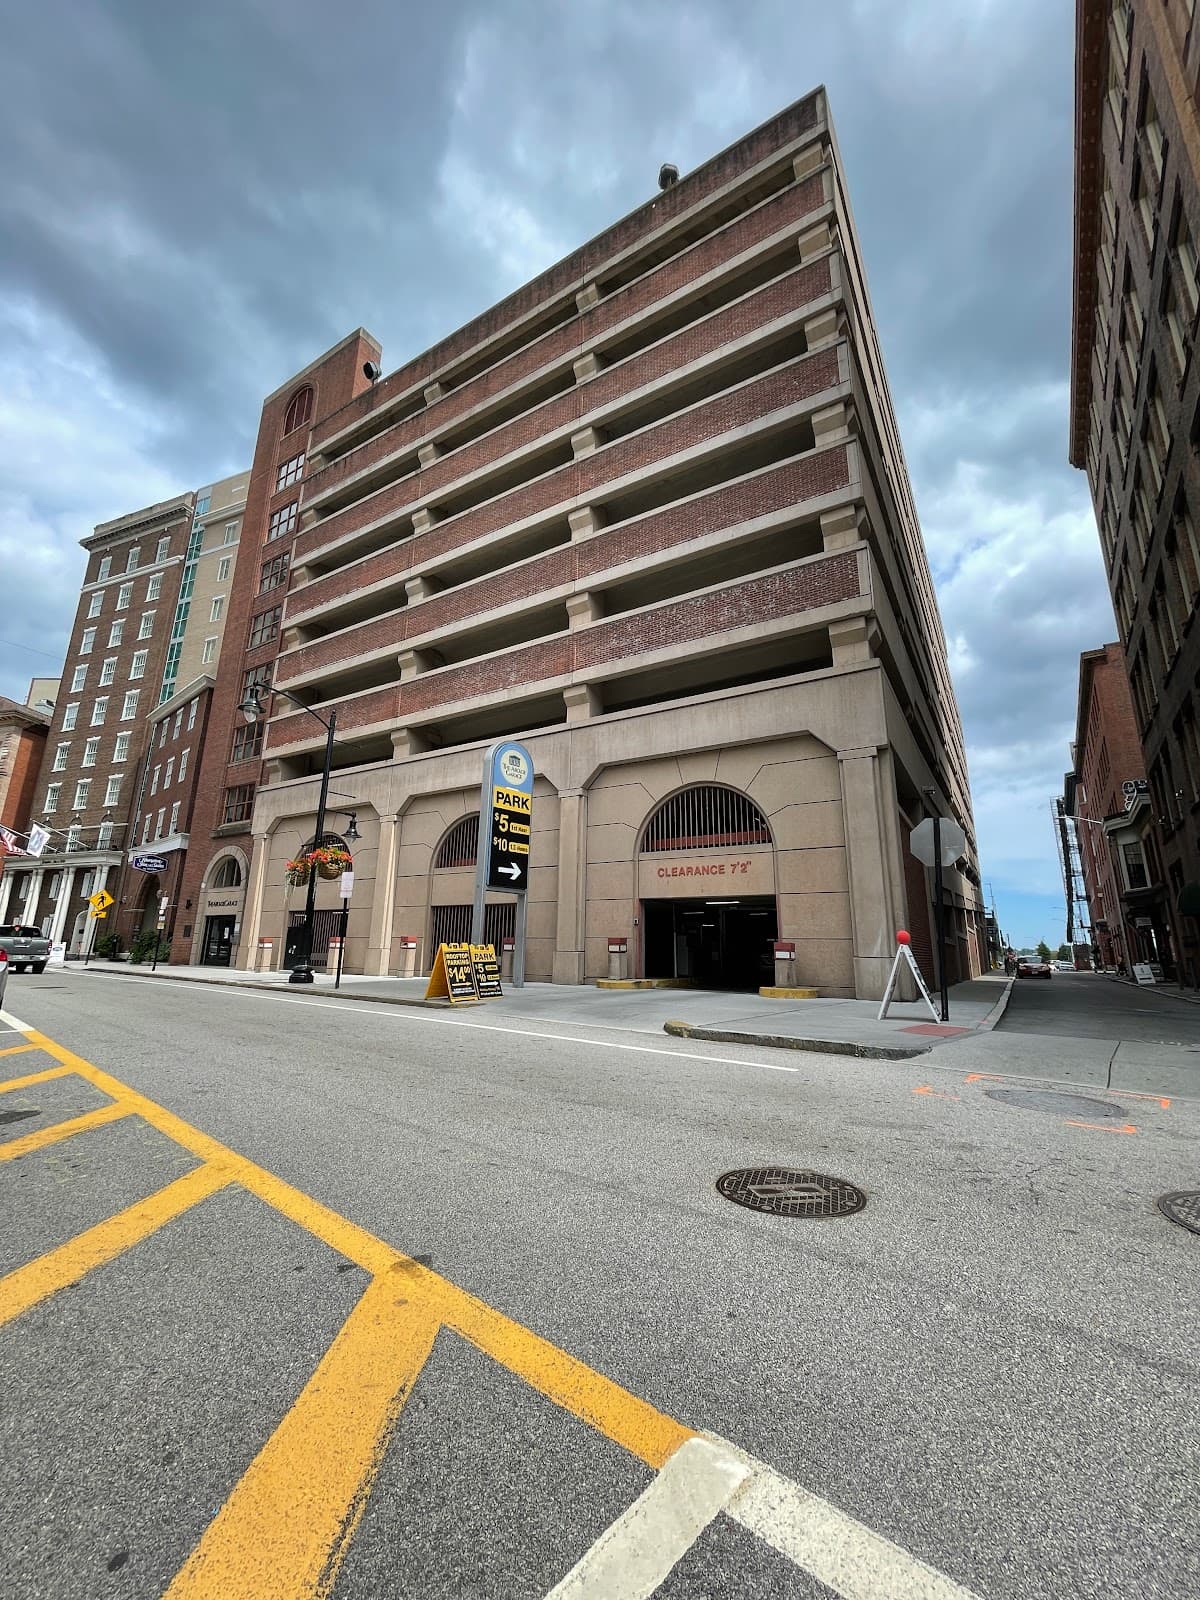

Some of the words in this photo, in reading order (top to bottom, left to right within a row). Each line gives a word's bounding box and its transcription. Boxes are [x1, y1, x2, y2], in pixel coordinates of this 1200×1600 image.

[496, 790, 530, 811] PARK
[494, 812, 509, 832] $5
[493, 836, 508, 852] $10
[657, 864, 726, 878] CLEARANCE
[730, 860, 752, 874] 7'2"
[474, 952, 494, 961] PARK
